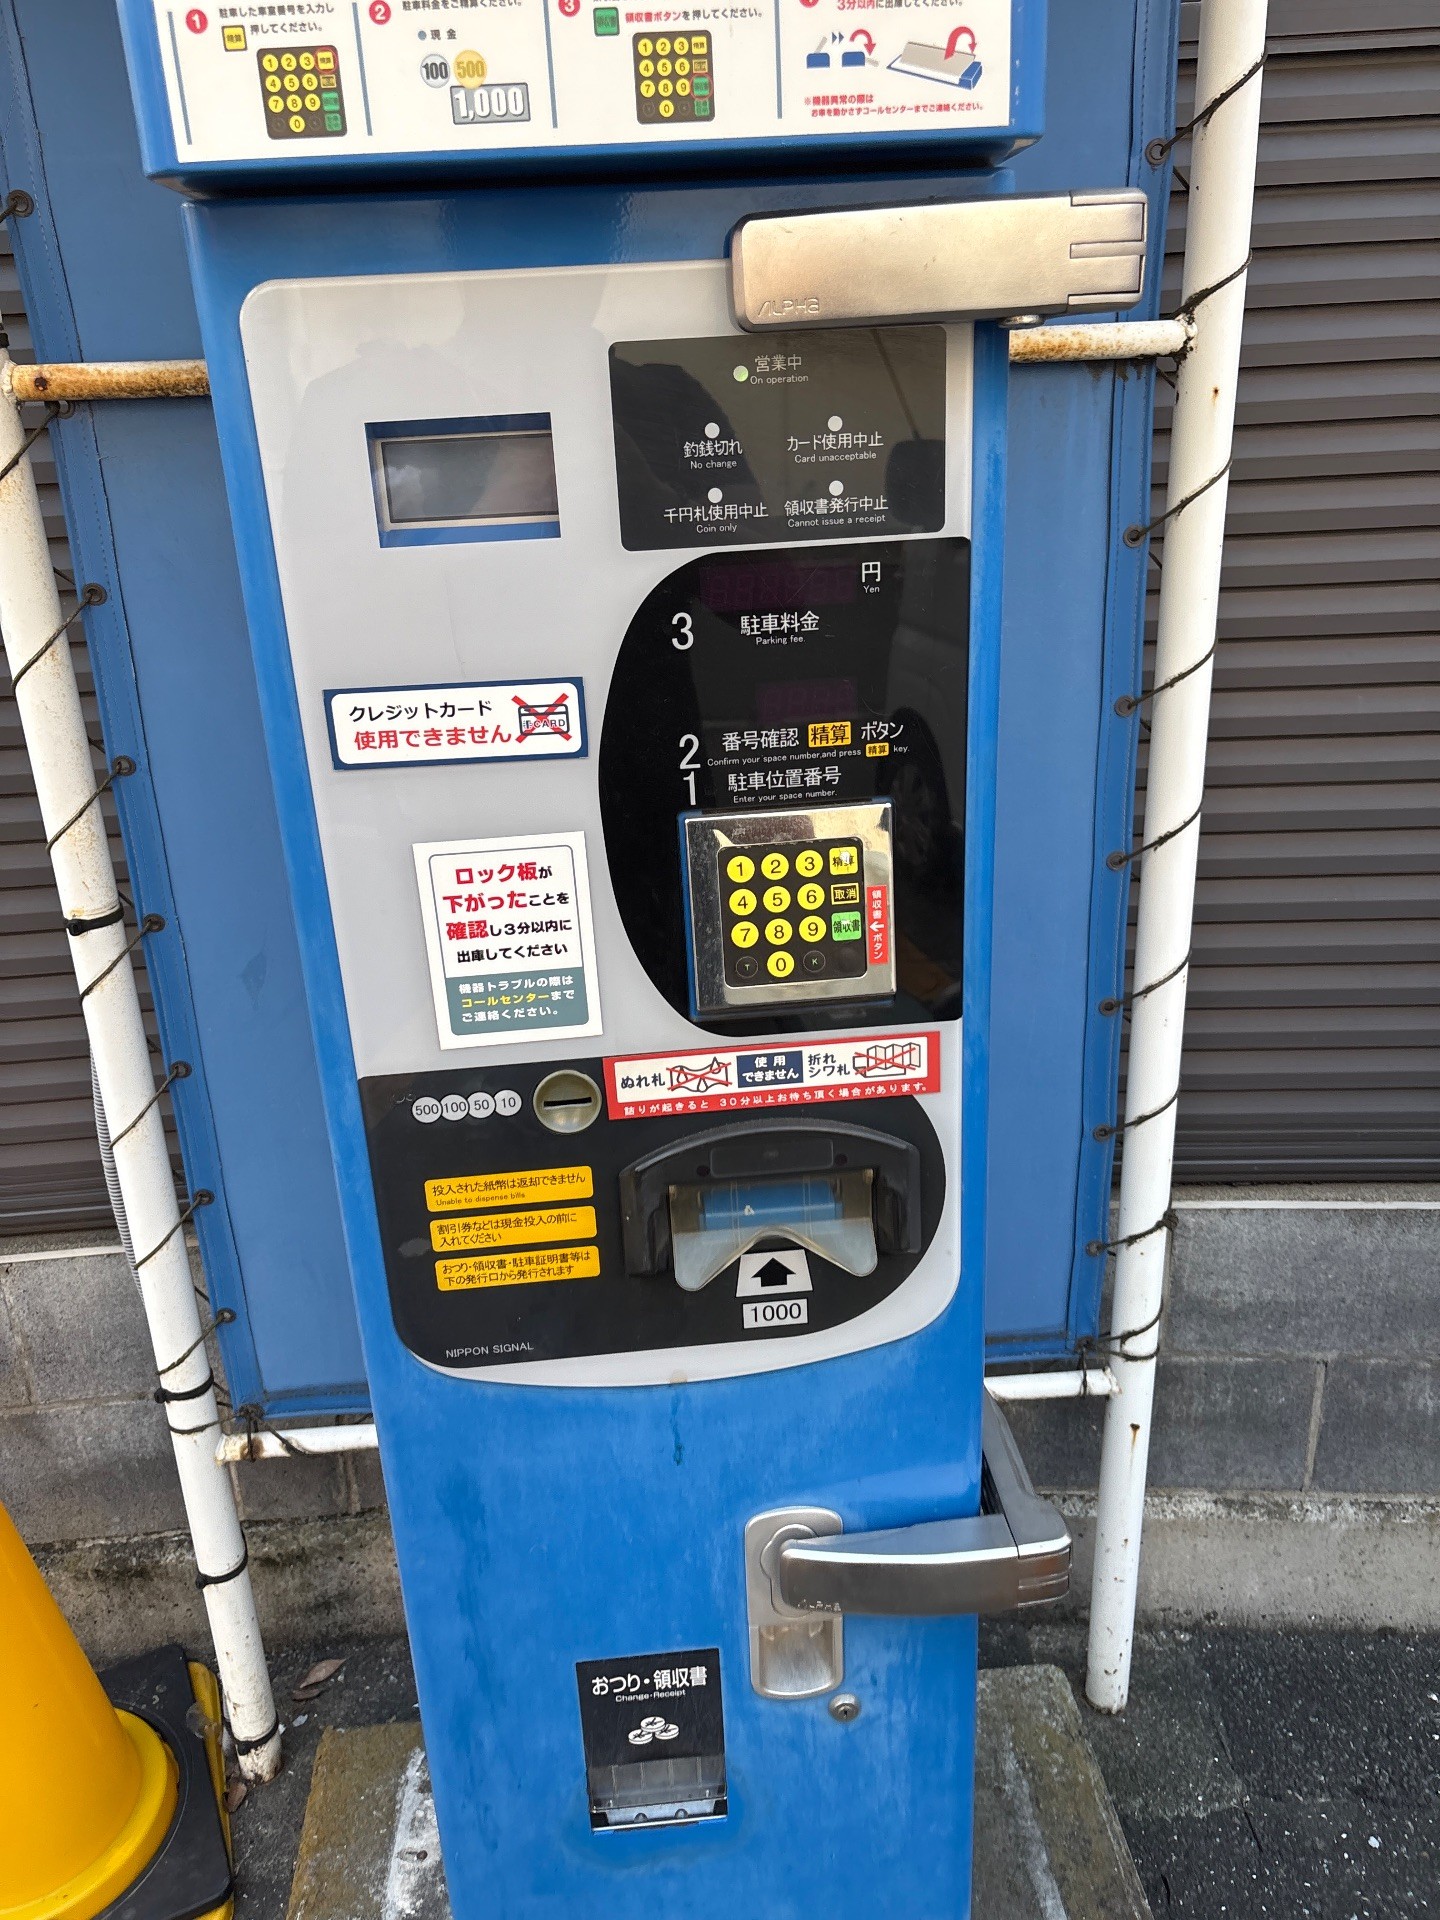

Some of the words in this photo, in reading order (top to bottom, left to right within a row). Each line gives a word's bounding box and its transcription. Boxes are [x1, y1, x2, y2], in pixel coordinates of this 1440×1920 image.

[374, 5, 386, 20] 2
[564, 0, 575, 12] 3
[191, 14, 200, 30] 1
[250, 22, 323, 35] 押してください。
[421, 62, 448, 80] 100
[457, 60, 486, 78] 500
[453, 86, 524, 121] 1,000
[754, 354, 802, 373] 営業中
[750, 375, 764, 385] On
[766, 374, 809, 386] operation
[683, 438, 743, 459] 釣銭切れ
[786, 431, 884, 452] カード使用中止
[690, 460, 703, 470] No
[705, 459, 738, 470] change
[794, 453, 816, 463] Card
[818, 451, 877, 463] unacceptable
[663, 502, 769, 523] 千円札使用中止
[783, 494, 889, 516] 領収書発行中止
[696, 524, 717, 534] Coin
[718, 523, 737, 534] only
[787, 517, 819, 528] Cannot
[821, 516, 845, 526] issue
[855, 514, 886, 526] receipt
[861, 561, 881, 583] 円
[863, 584, 881, 594] Yen
[671, 612, 695, 650] 3
[740, 610, 820, 636] 駐車料金
[755, 635, 788, 646] Parking
[790, 634, 806, 644] fee.
[348, 700, 493, 723] クレジットカード
[354, 724, 512, 751] 使用できません
[722, 727, 800, 752] 番号確認
[810, 723, 850, 746] 精算
[860, 721, 904, 741] ボタン
[679, 734, 701, 770] 2
[707, 757, 740, 767] Confirm
[742, 755, 760, 766] your
[762, 754, 787, 764] space
[839, 749, 862, 759] press
[867, 744, 889, 756] 精算
[893, 744, 910, 754] key.
[683, 771, 697, 806] 1
[727, 765, 842, 793] 駐車位置番号
[733, 794, 755, 804] Enter
[758, 793, 777, 803] your
[778, 792, 803, 802] space
[805, 789, 838, 799] number.
[455, 862, 553, 886] ロック板が
[736, 862, 744, 877] 1
[770, 859, 782, 874] 2
[804, 856, 815, 871] 3
[443, 890, 570, 914] 下がったことを
[737, 895, 749, 909] 4
[772, 893, 783, 907] 5
[806, 890, 817, 904] 6
[834, 888, 856, 900] 取消
[872, 889, 882, 920] 領収書
[446, 919, 573, 941] 確認し3分以内に
[739, 928, 751, 942] 7
[773, 925, 785, 940] 8
[807, 922, 819, 937] 9
[832, 919, 860, 933] 領収書
[456, 942, 569, 964] 出庫してください
[873, 932, 883, 960] ボタン
[775, 957, 787, 972] 0
[458, 974, 574, 995] 機器トラブルの際は
[461, 989, 575, 1008] コールセンターまで
[461, 1006, 558, 1023] ご連絡ください。
[754, 1055, 787, 1068] 使用
[807, 1053, 837, 1066] 折れ
[620, 1072, 666, 1089] ぬれ札
[742, 1068, 800, 1083] できません
[808, 1063, 851, 1078] シワ札
[415, 1103, 439, 1116] 500
[443, 1101, 467, 1114] 100
[474, 1099, 490, 1111] 50
[501, 1096, 516, 1109] 10
[432, 1172, 586, 1197] 投入された紙幣は返却できません
[435, 1197, 462, 1207] Unable
[464, 1196, 473, 1204] to
[475, 1193, 509, 1205] dispense
[436, 1211, 578, 1236] 割引券などは現金投入の前に
[439, 1232, 502, 1248] 入れてください
[442, 1250, 591, 1275] おつり・領収書・駐車証明書等は
[444, 1264, 575, 1287] 下の発行口から発行されます
[749, 1302, 802, 1323] 1000
[445, 1345, 489, 1359] NIPPON
[492, 1341, 535, 1354] SIGNAL
[591, 1665, 708, 1696] おつり・領収書
